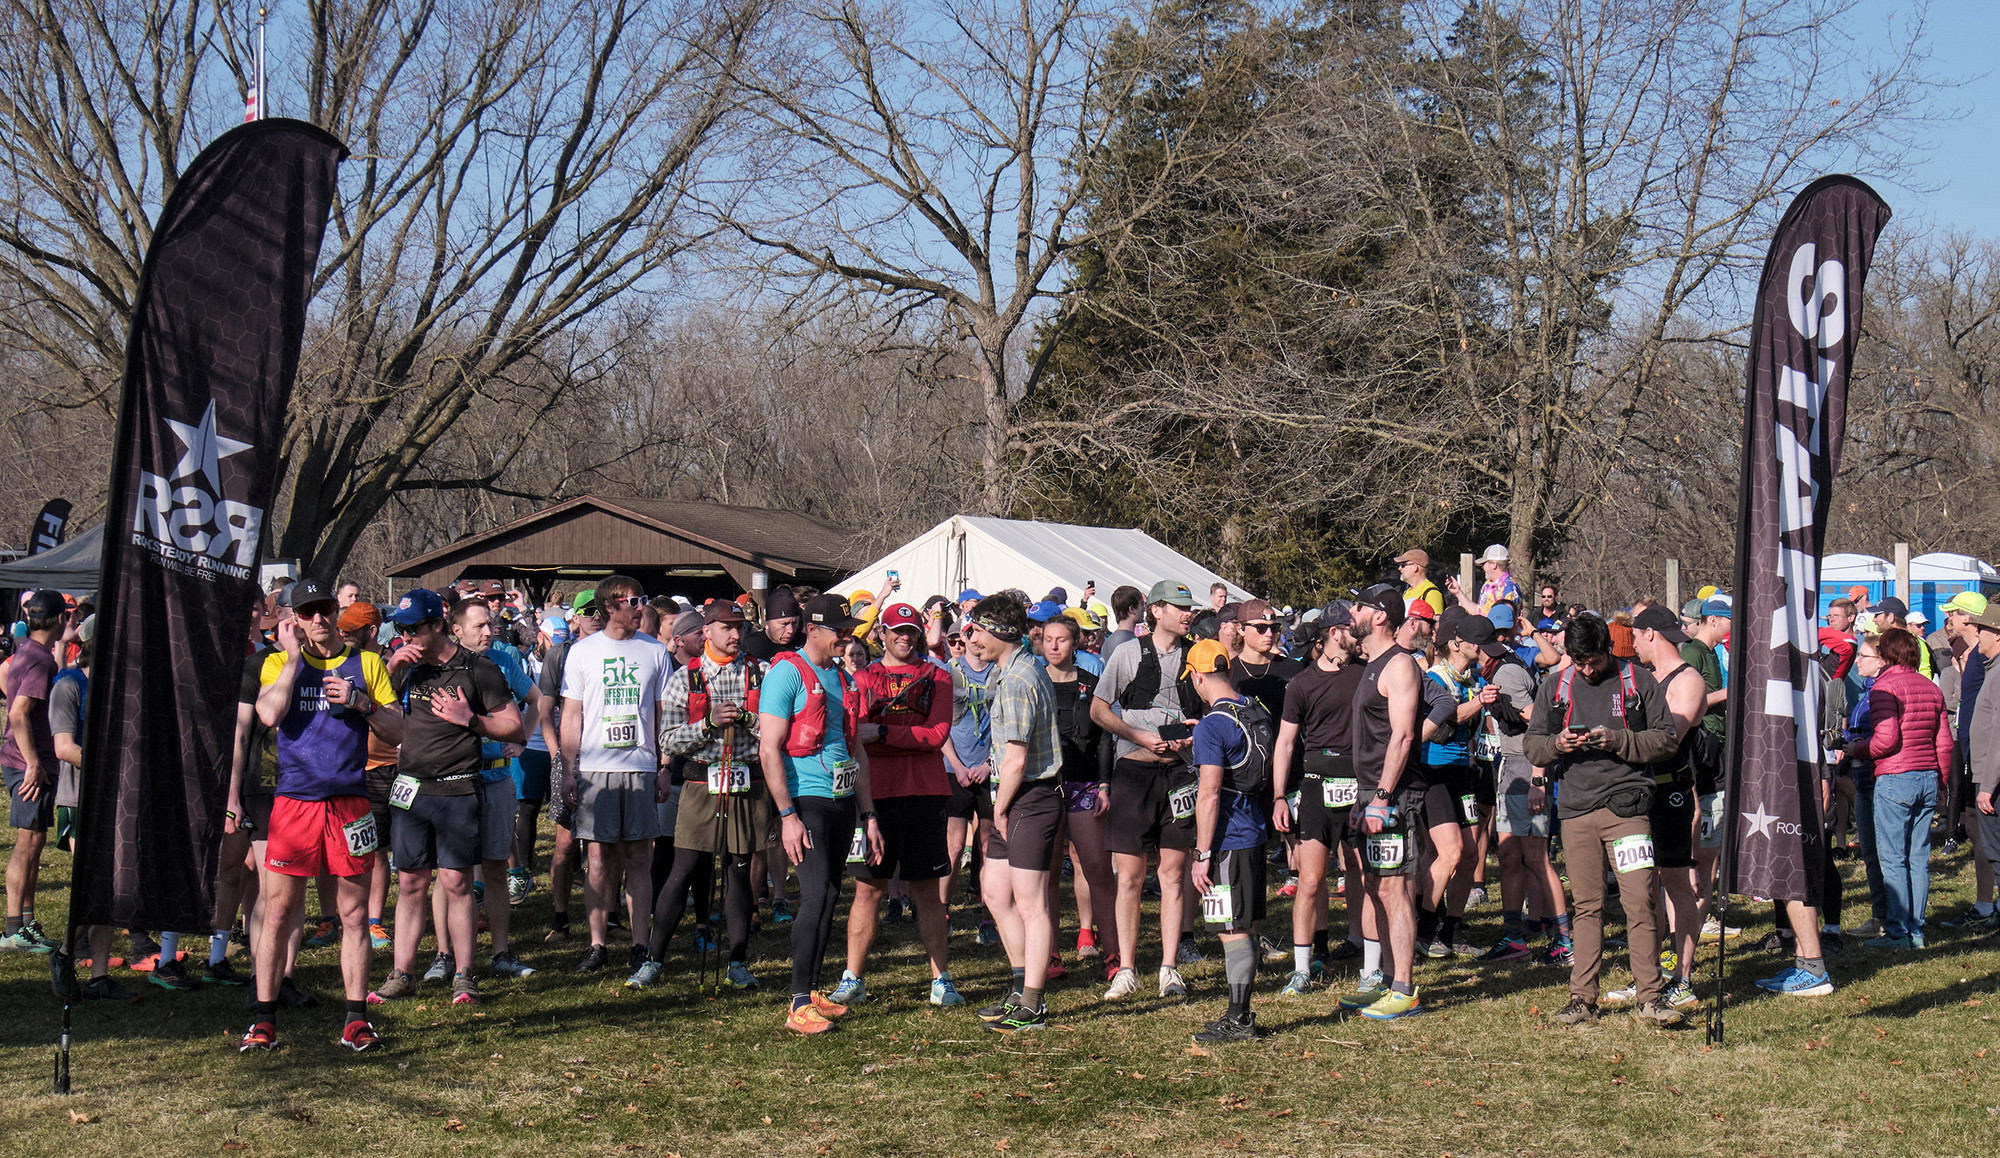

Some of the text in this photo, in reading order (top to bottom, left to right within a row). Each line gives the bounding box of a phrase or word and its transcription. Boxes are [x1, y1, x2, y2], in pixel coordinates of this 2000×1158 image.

[35, 512, 63, 554] FI
[197, 555, 251, 580] RUNNING
[612, 698, 624, 706] THE
[605, 724, 636, 742] 1997
[350, 825, 376, 851] 202
[1367, 844, 1399, 862] 1857
[1791, 977, 1816, 991] TERREX
